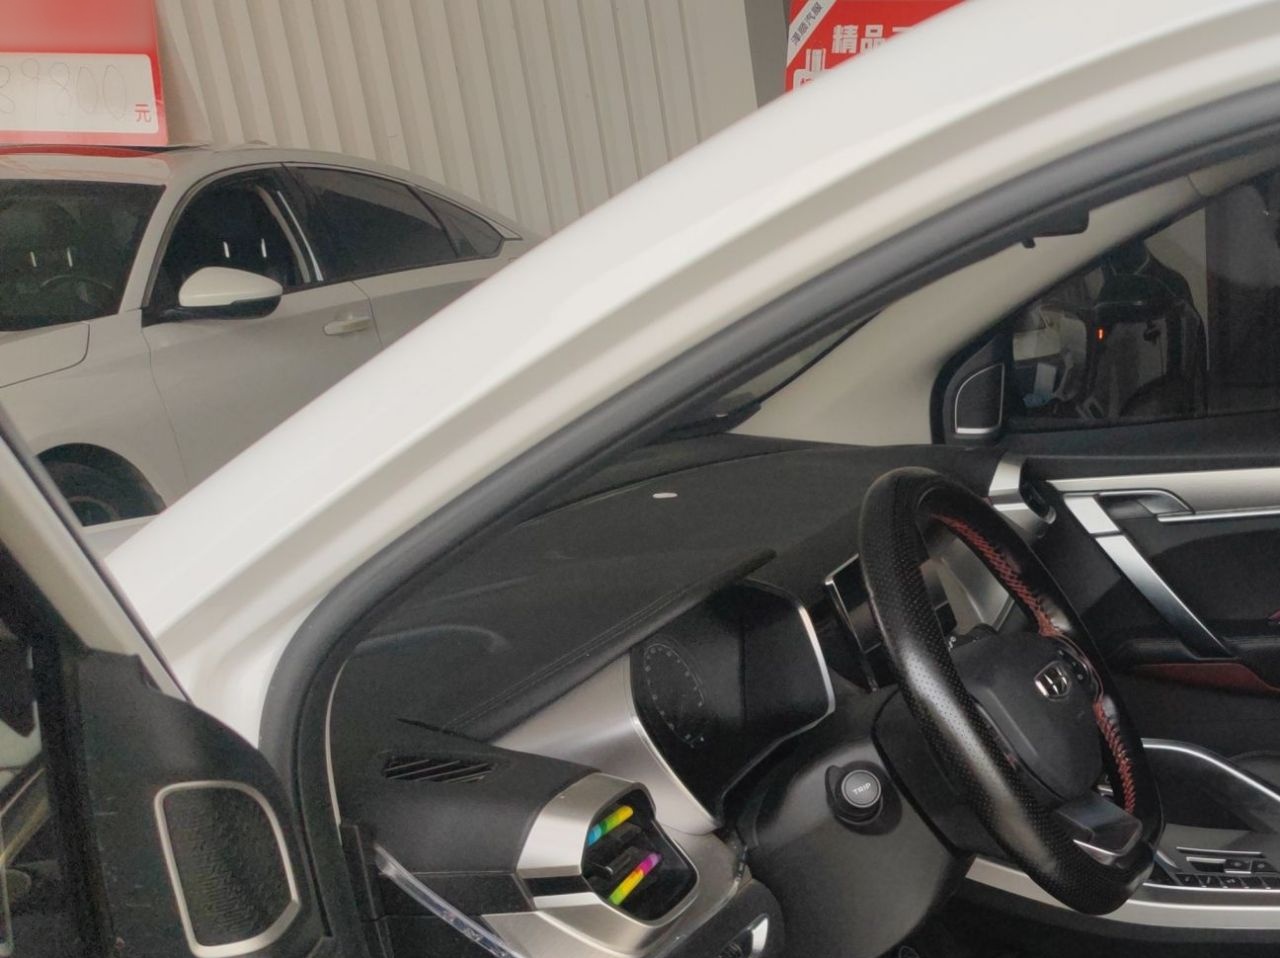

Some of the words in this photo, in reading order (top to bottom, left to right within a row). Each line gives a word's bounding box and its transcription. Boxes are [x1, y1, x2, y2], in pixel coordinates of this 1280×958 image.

[832, 24, 912, 54] 精品
[134, 103, 151, 122] 元
[853, 782, 871, 795] TRIP
